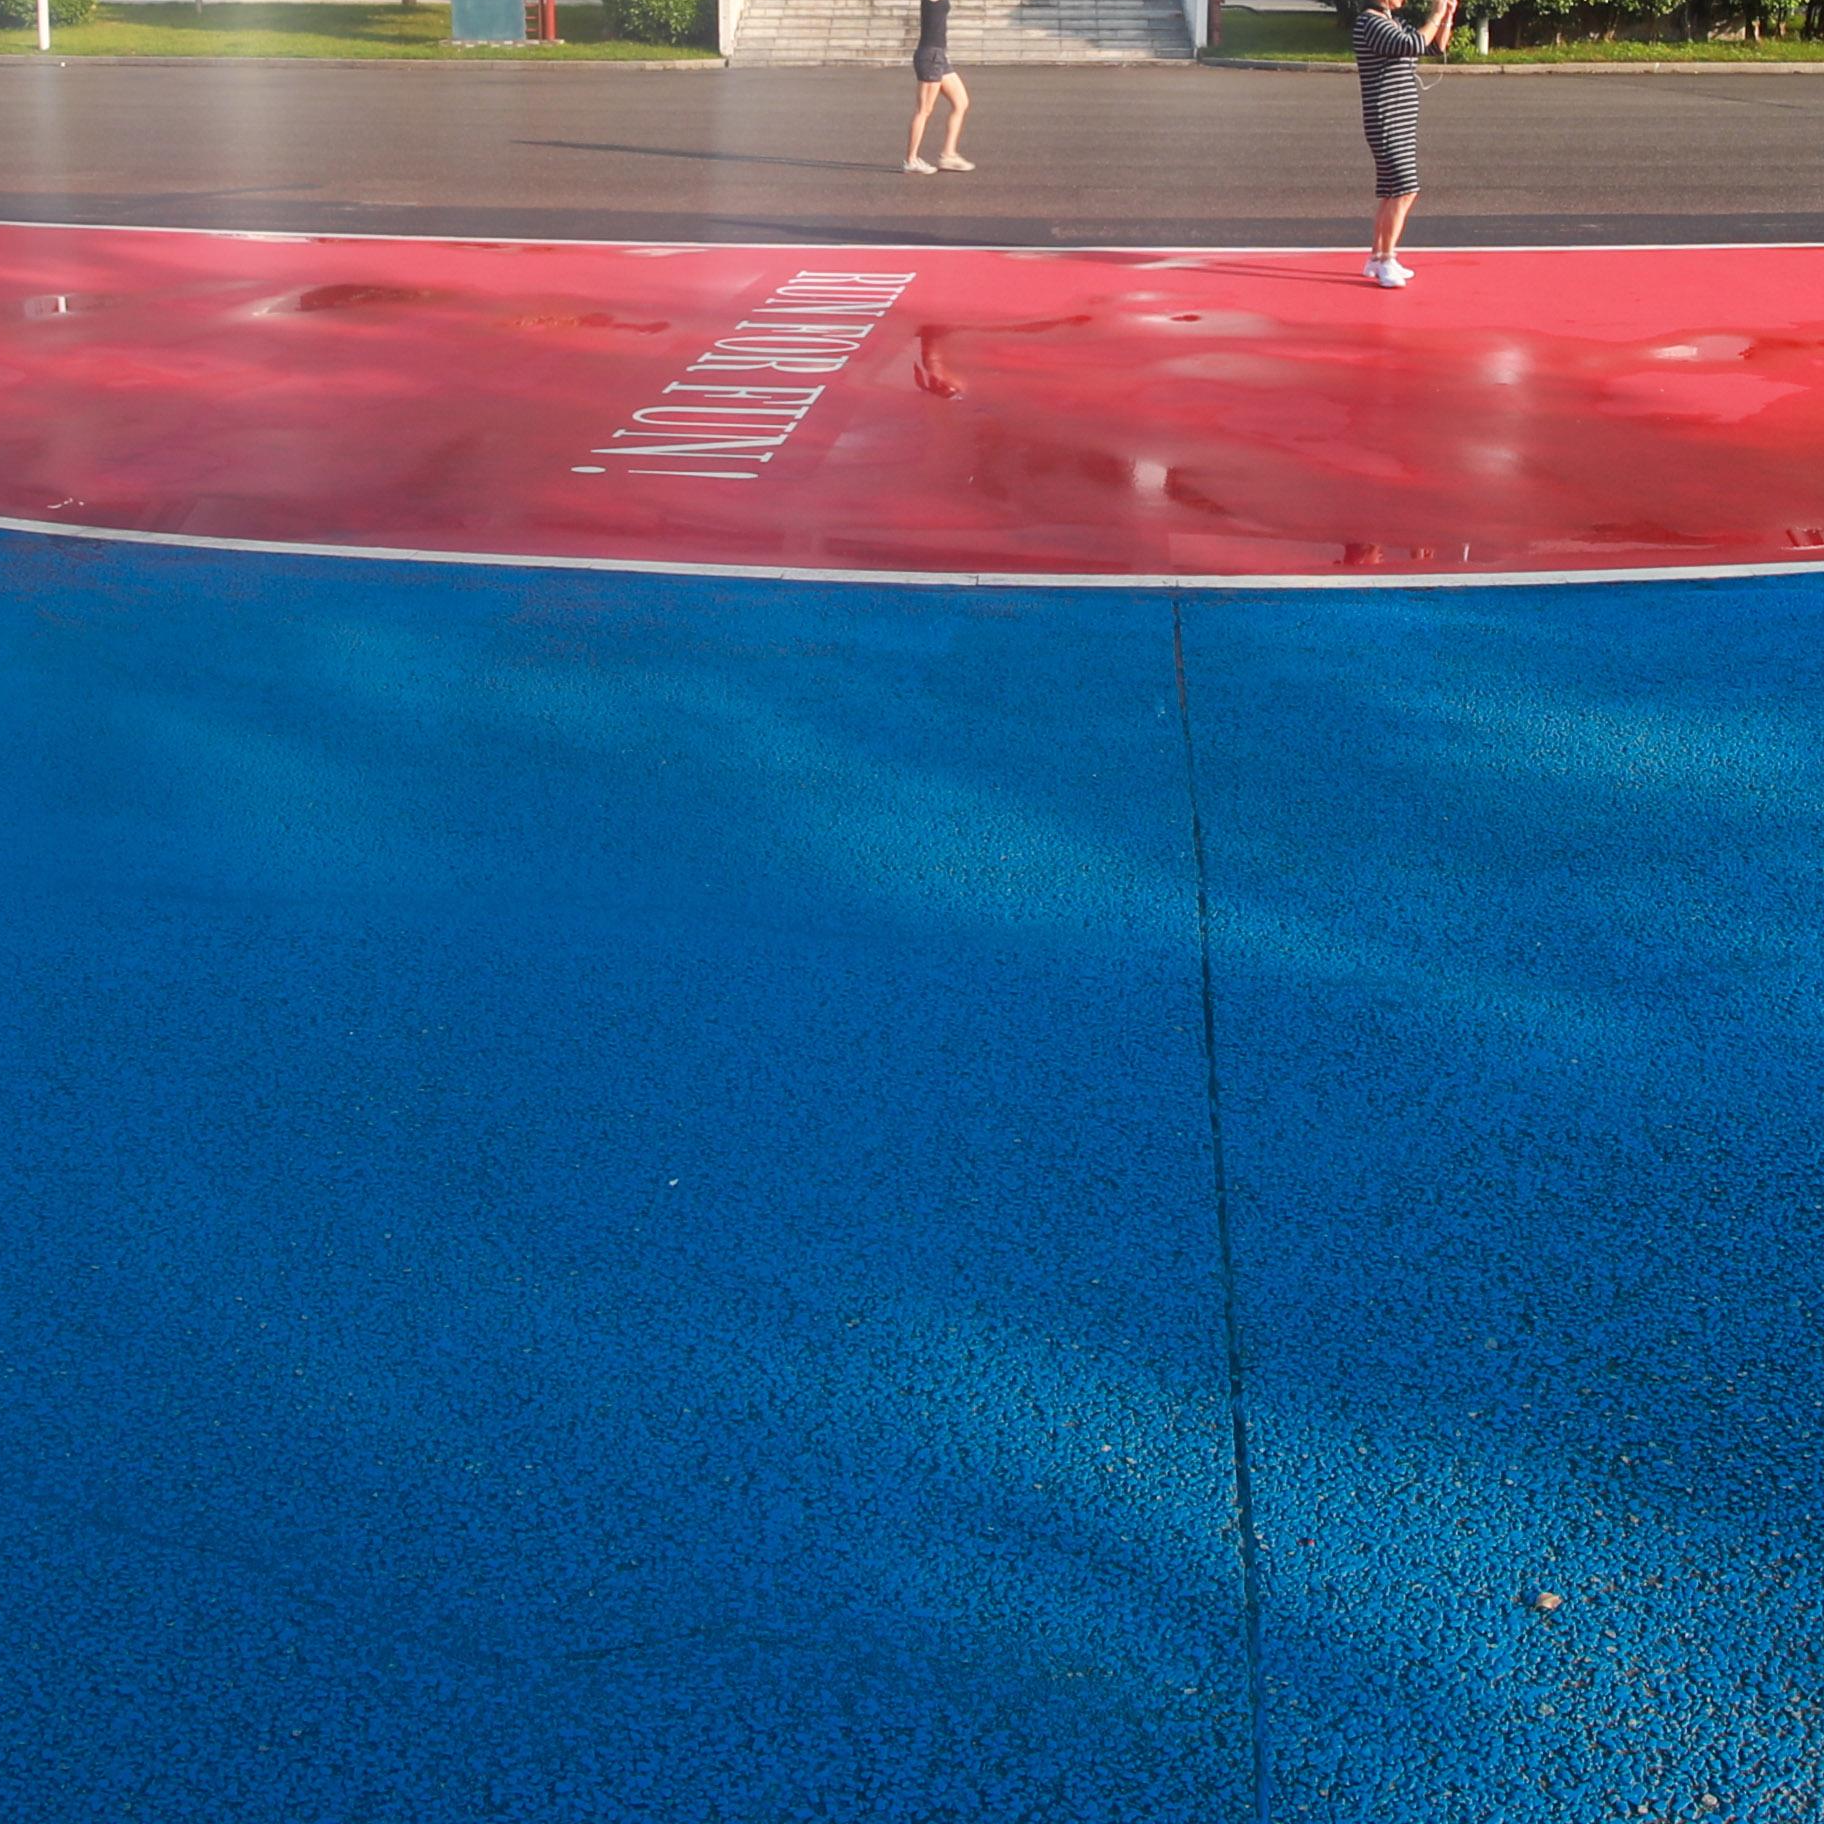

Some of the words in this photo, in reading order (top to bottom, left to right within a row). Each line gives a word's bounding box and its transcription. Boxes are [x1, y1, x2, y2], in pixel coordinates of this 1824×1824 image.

[752, 270, 916, 317] RUN
[685, 320, 875, 374] FOR
[570, 380, 827, 480] FUN!
